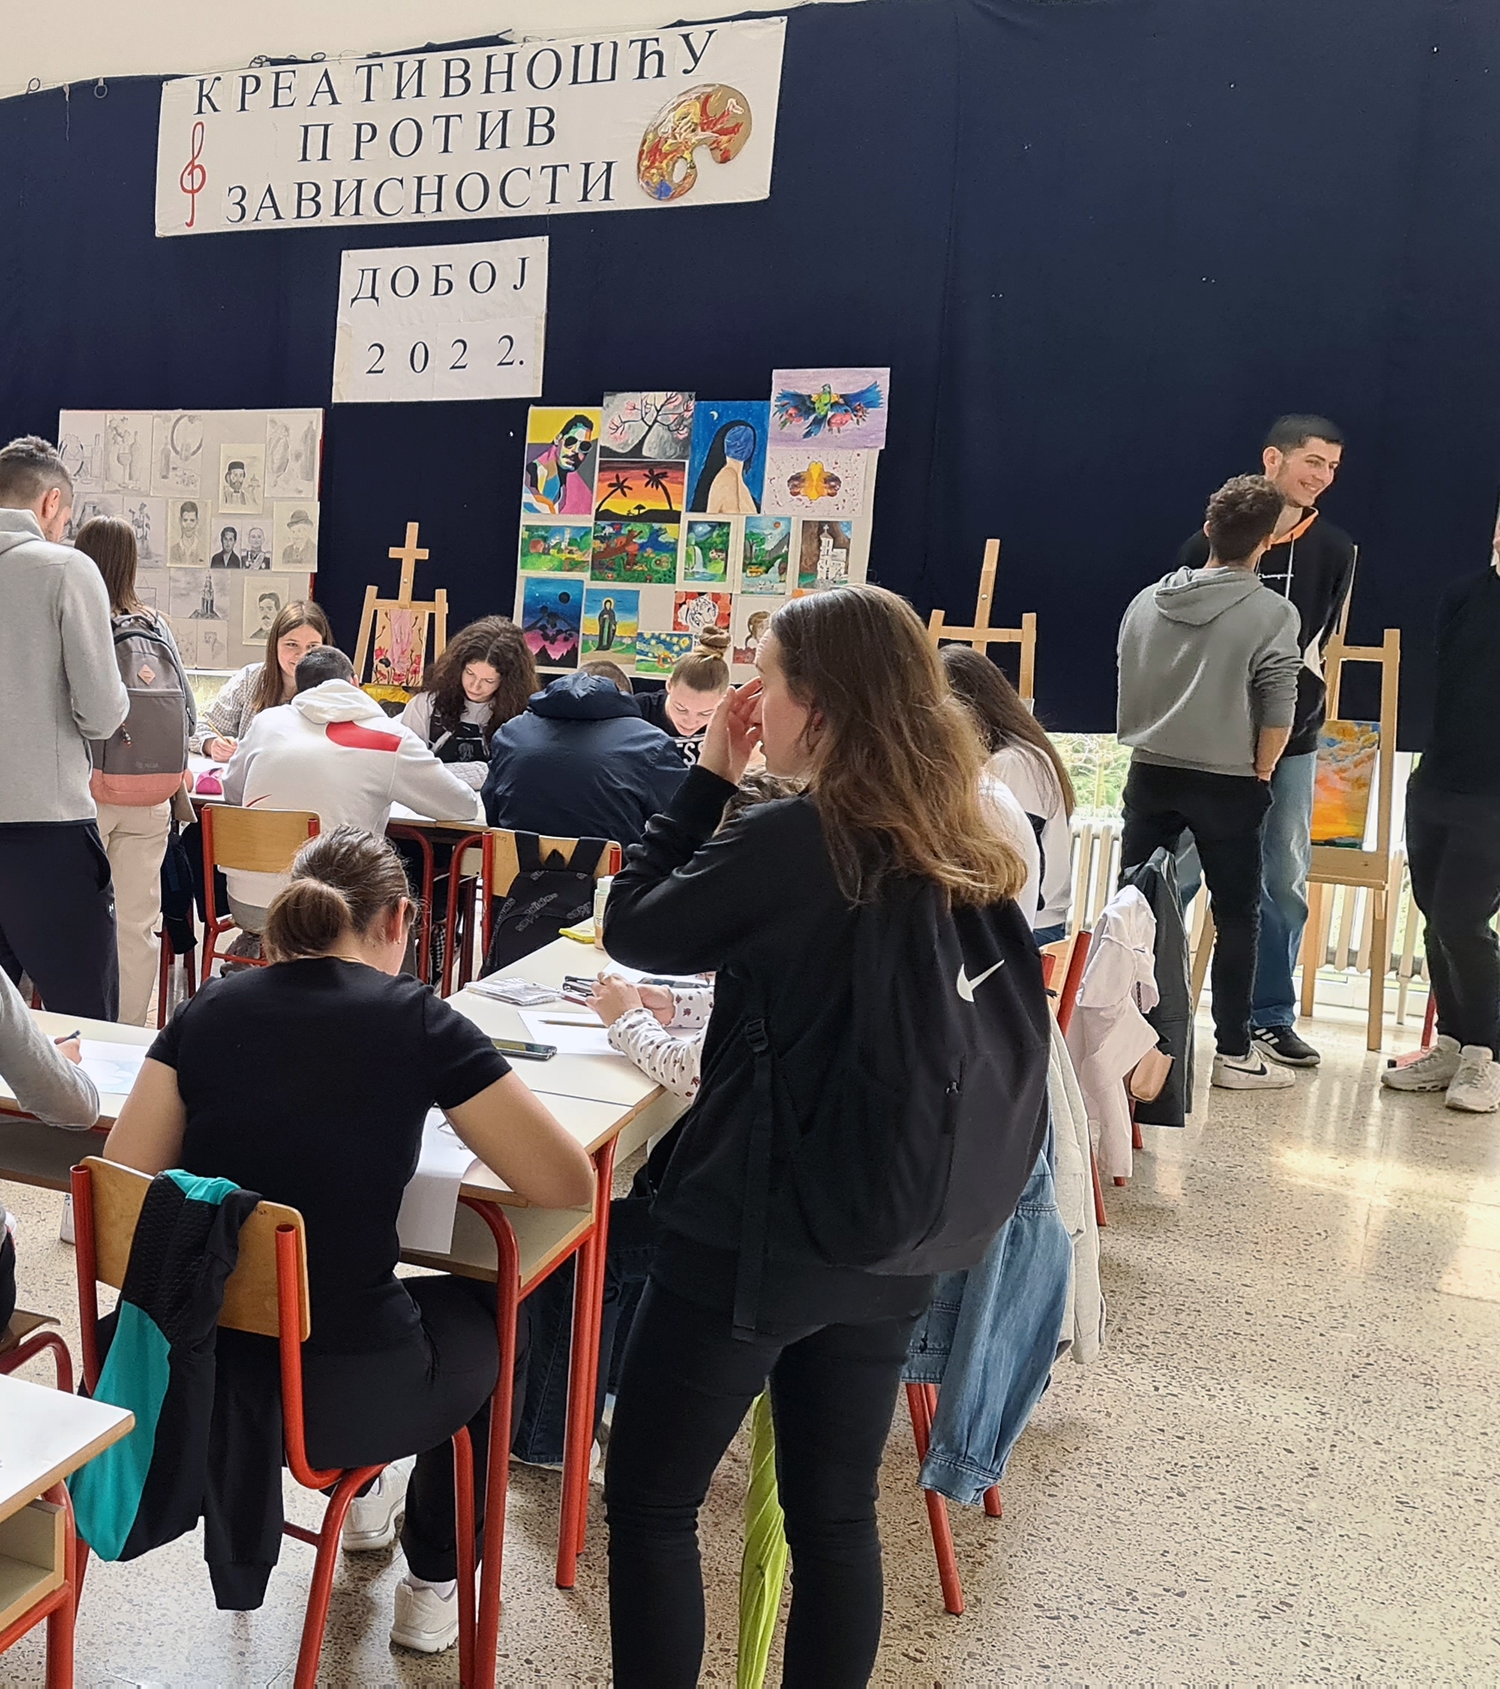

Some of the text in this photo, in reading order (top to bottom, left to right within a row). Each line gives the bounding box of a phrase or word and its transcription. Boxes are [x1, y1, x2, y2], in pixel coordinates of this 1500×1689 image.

[193, 28, 718, 117] КРЕАТИВНОШЋУ
[297, 105, 557, 163] ПРОТИВ
[225, 160, 618, 225] ЗАВИСНОСТИ
[350, 256, 530, 309] ДОБОЈ
[366, 335, 526, 376] 2022.
